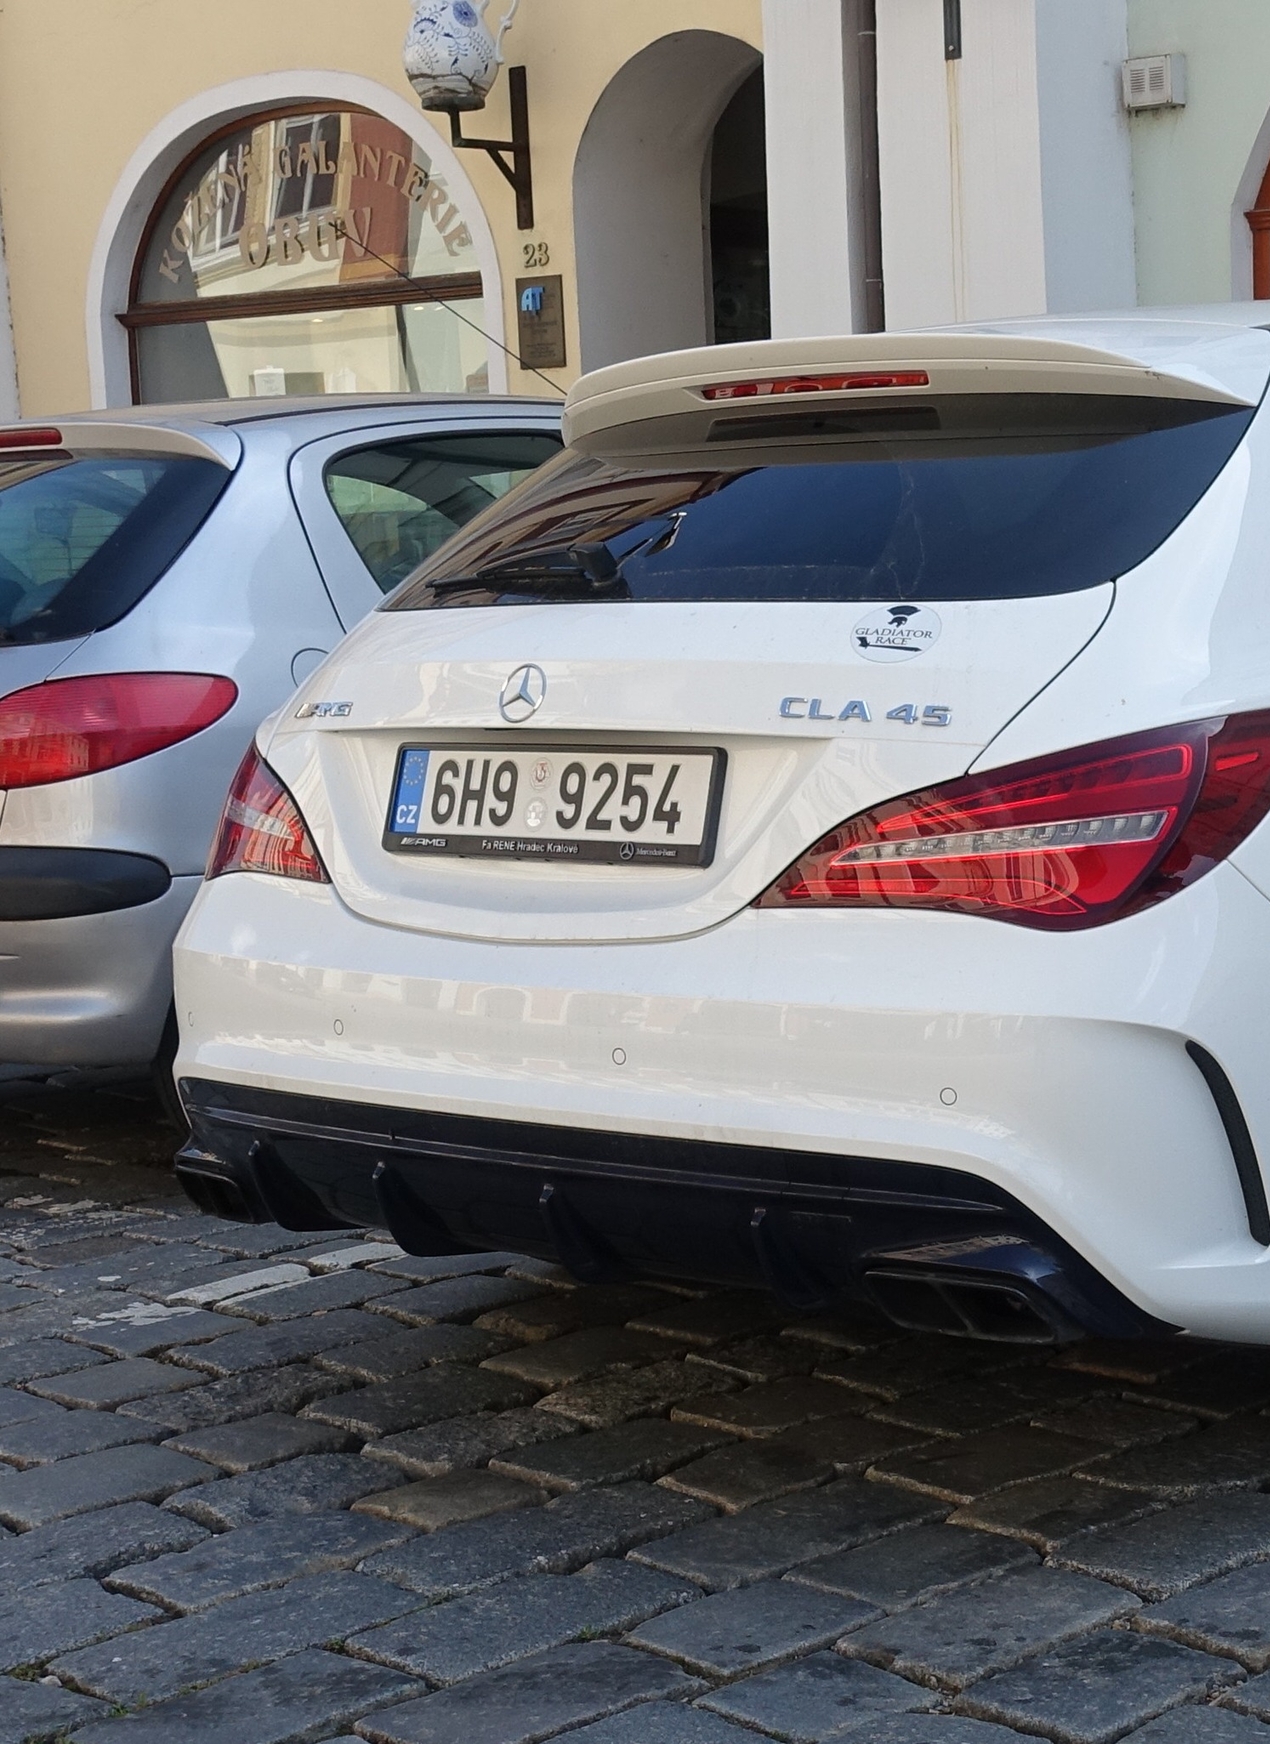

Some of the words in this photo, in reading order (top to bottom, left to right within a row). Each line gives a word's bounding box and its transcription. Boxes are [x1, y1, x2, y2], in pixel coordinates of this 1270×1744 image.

[272, 140, 474, 257] GALANTERIE
[239, 206, 373, 269] OBUV
[523, 242, 550, 269] 23
[521, 286, 543, 311] AT
[855, 627, 933, 639] GLADIATOR
[875, 636, 909, 646] RACE
[779, 696, 872, 722] CLA
[886, 703, 952, 727] 45
[431, 758, 519, 827] 6H9
[555, 761, 682, 834] 9254
[396, 804, 418, 824] CZ
[516, 841, 545, 852] Hradec
